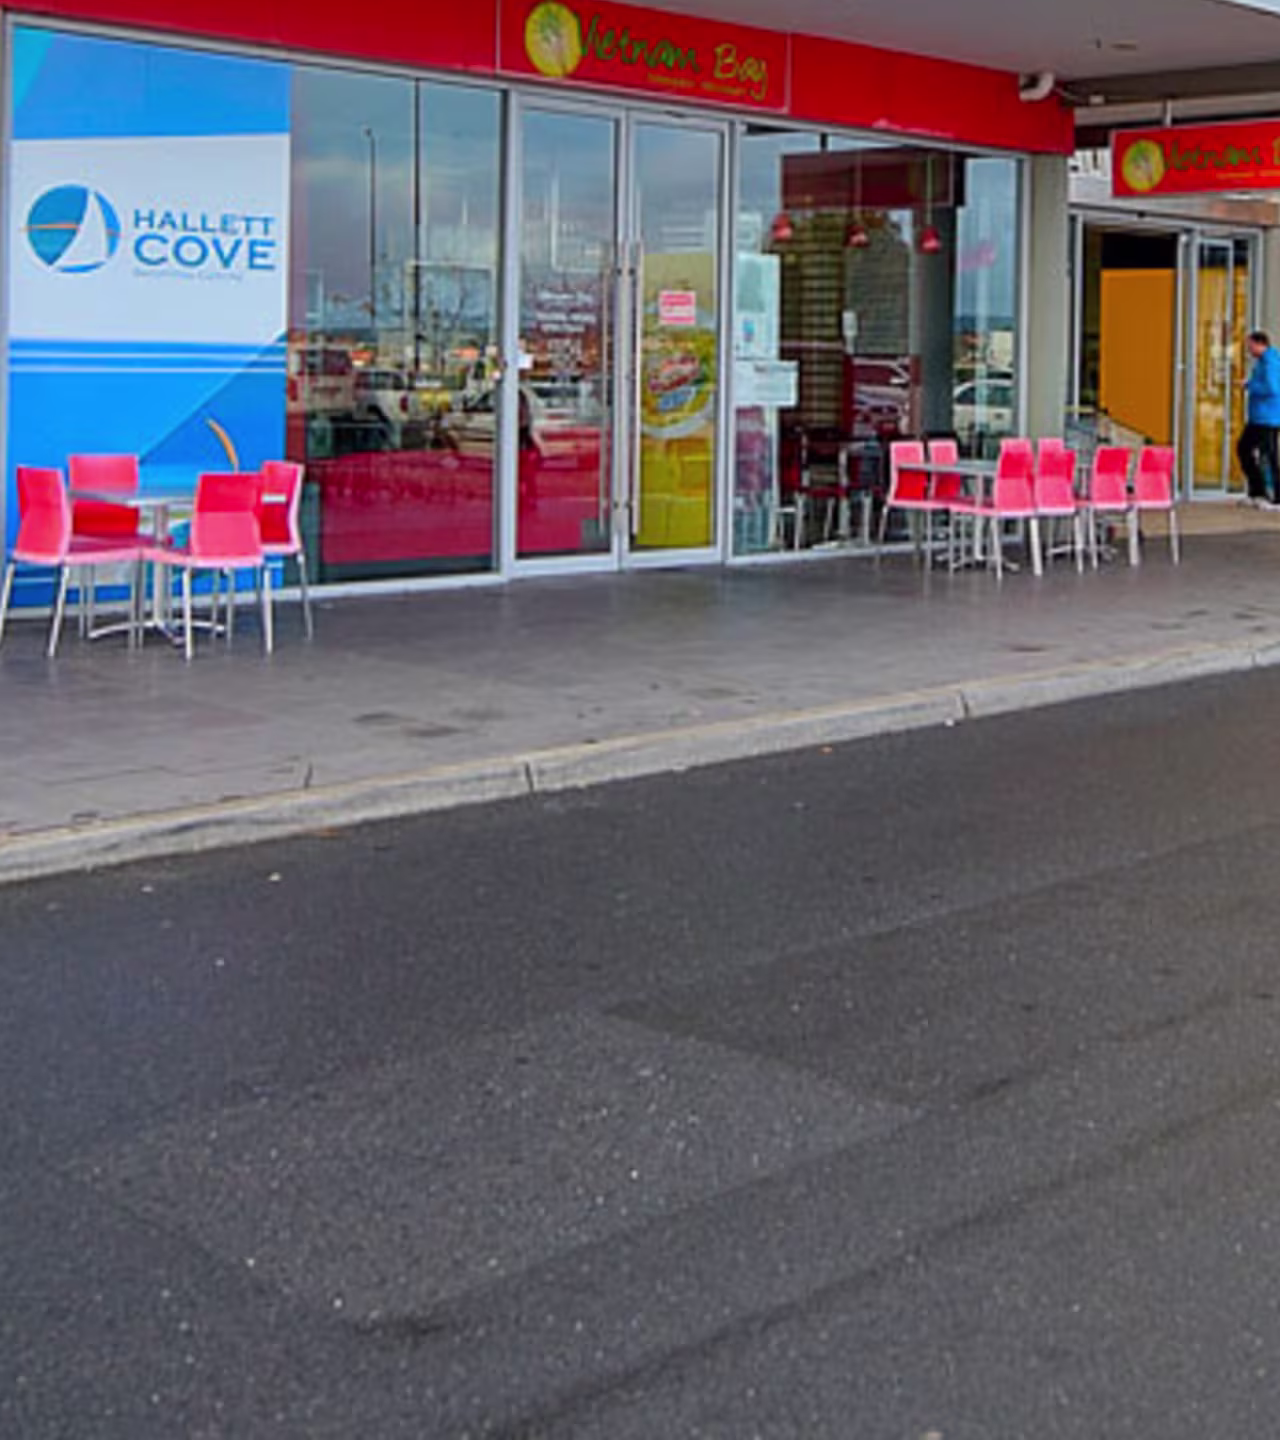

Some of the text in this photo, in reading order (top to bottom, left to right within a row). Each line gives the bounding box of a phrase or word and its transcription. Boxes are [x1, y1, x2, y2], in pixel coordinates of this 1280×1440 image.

[713, 43, 768, 101] Bay
[133, 209, 276, 236] HALLETT
[133, 233, 277, 271] COVE
